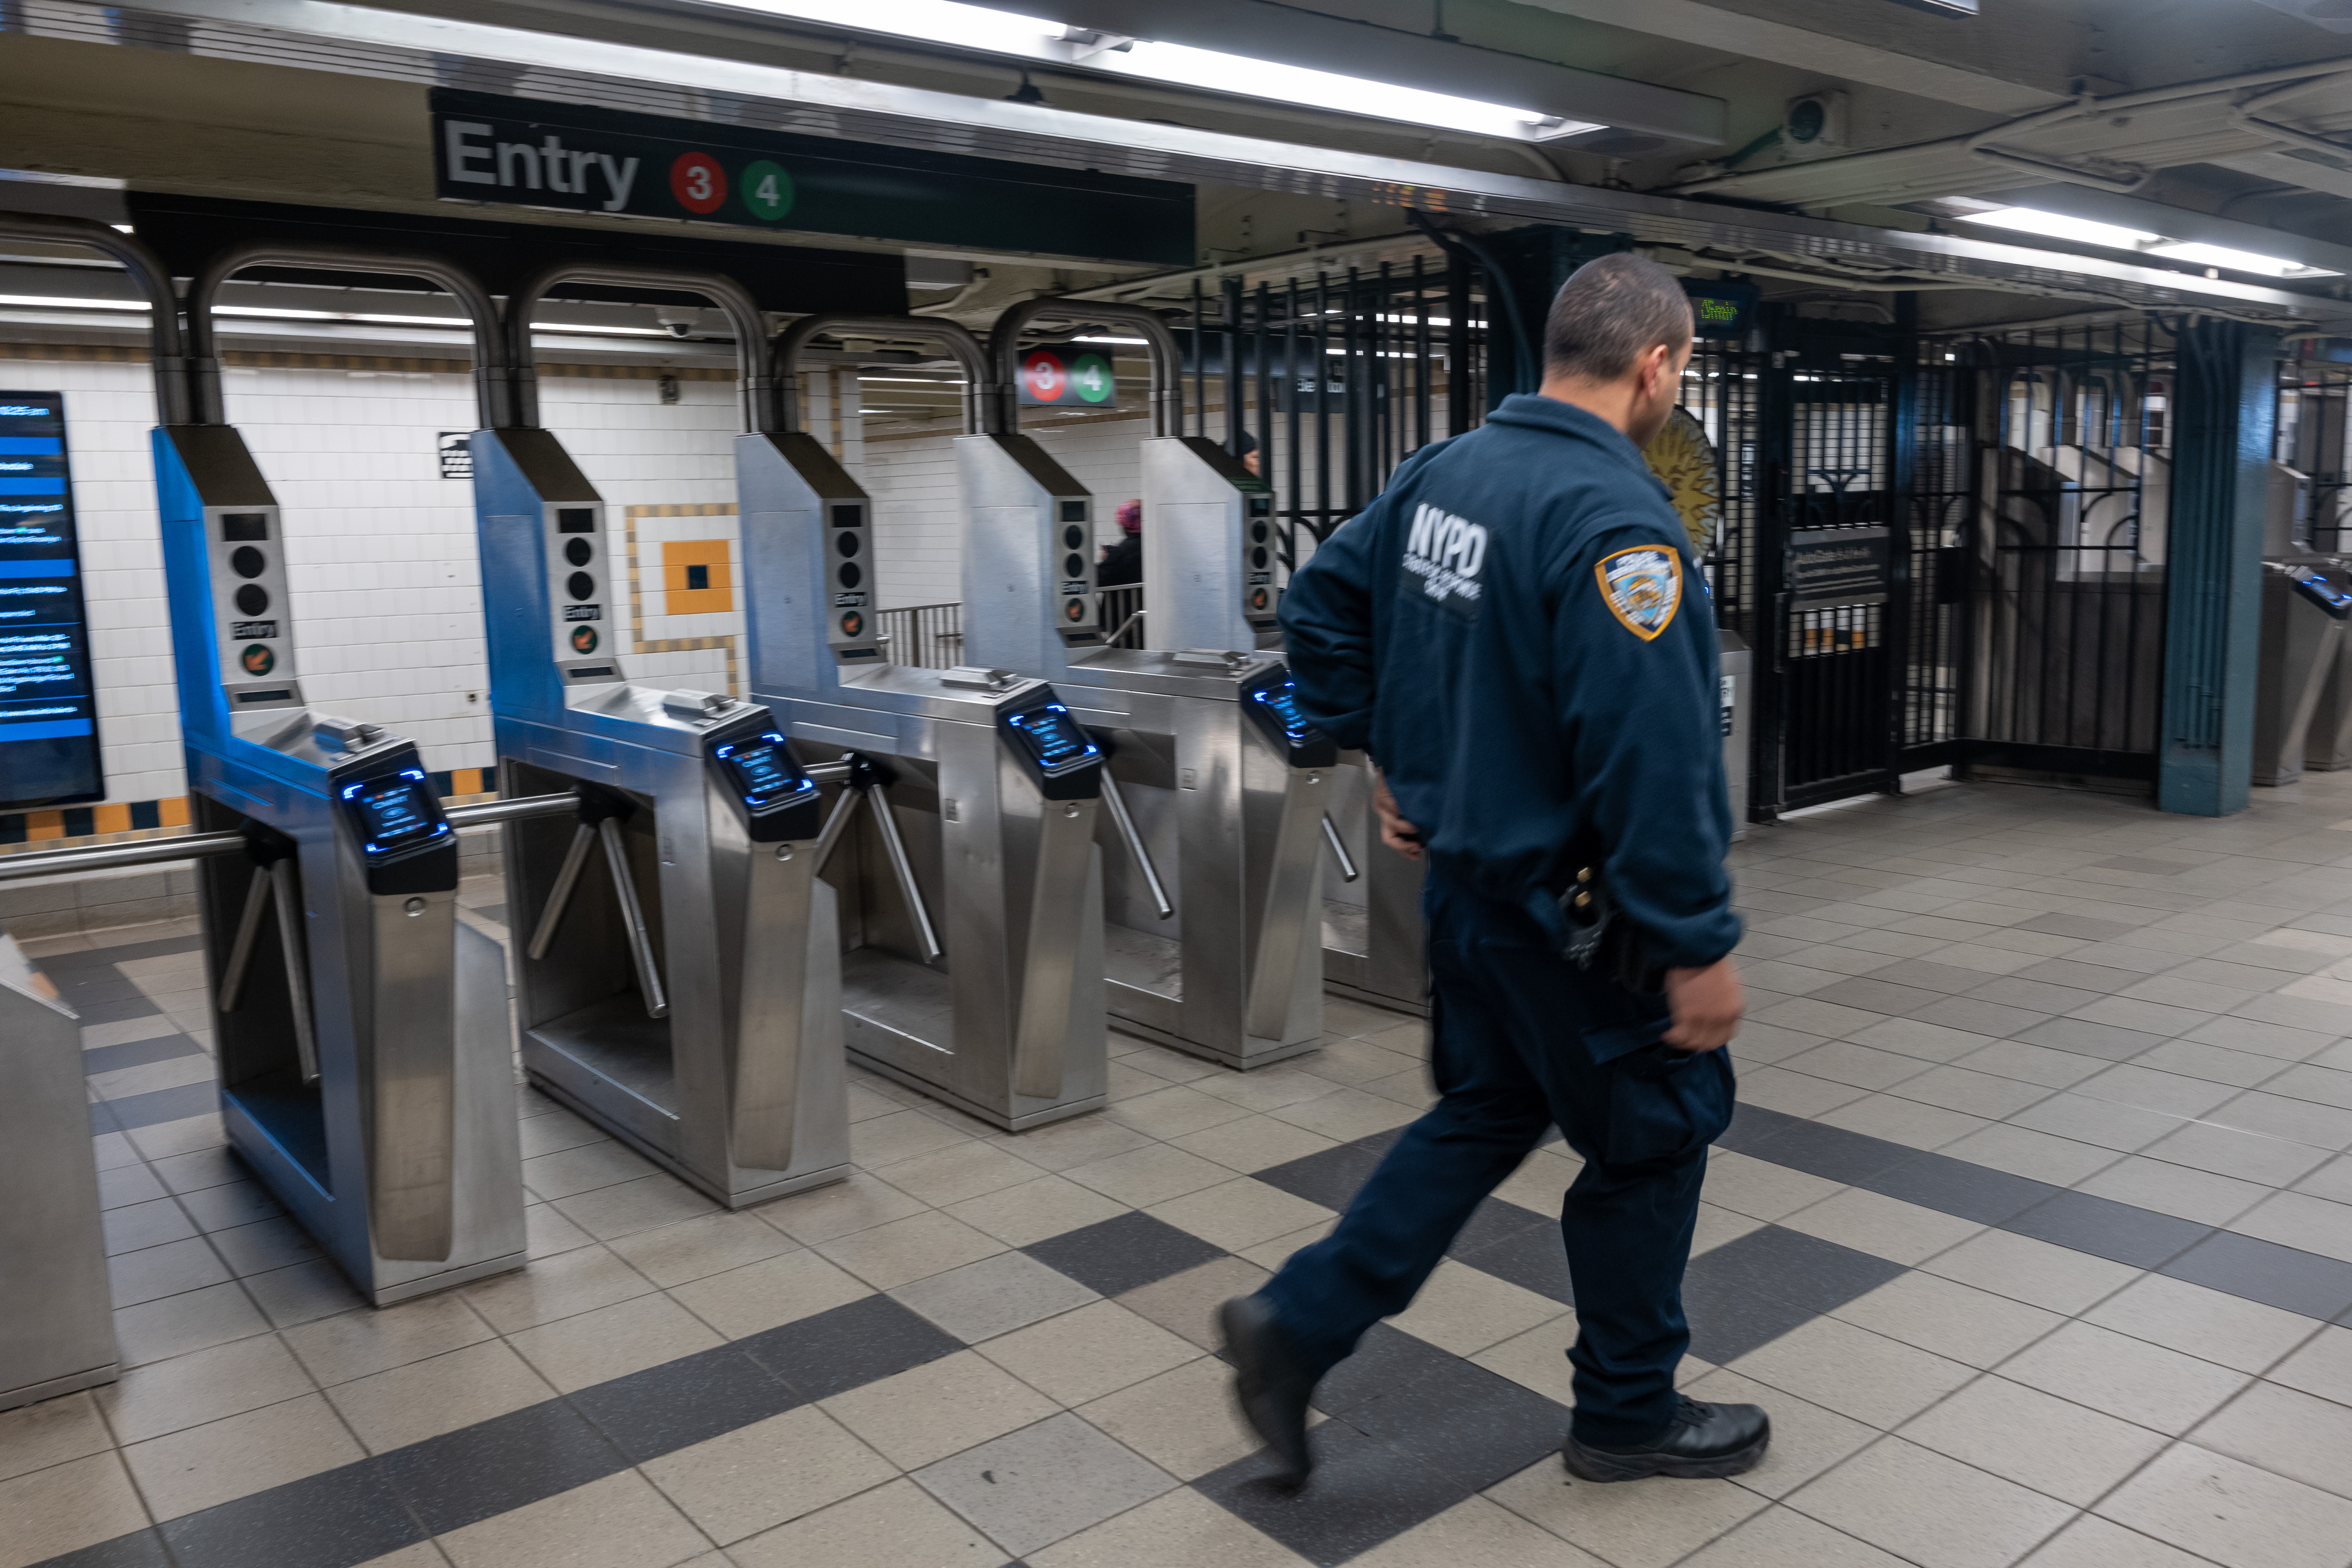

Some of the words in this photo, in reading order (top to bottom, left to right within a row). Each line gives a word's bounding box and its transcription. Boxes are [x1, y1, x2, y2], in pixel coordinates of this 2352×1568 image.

[444, 120, 641, 211] Entry
[685, 167, 711, 200] 3
[755, 175, 781, 206] 4
[1036, 362, 1054, 389] 3
[1083, 365, 1103, 390] 4
[1407, 503, 1488, 578] NYPD
[1062, 582, 1087, 594] Entry
[836, 593, 865, 606] Entry
[564, 606, 599, 620] Entry
[233, 623, 276, 638] Entry
